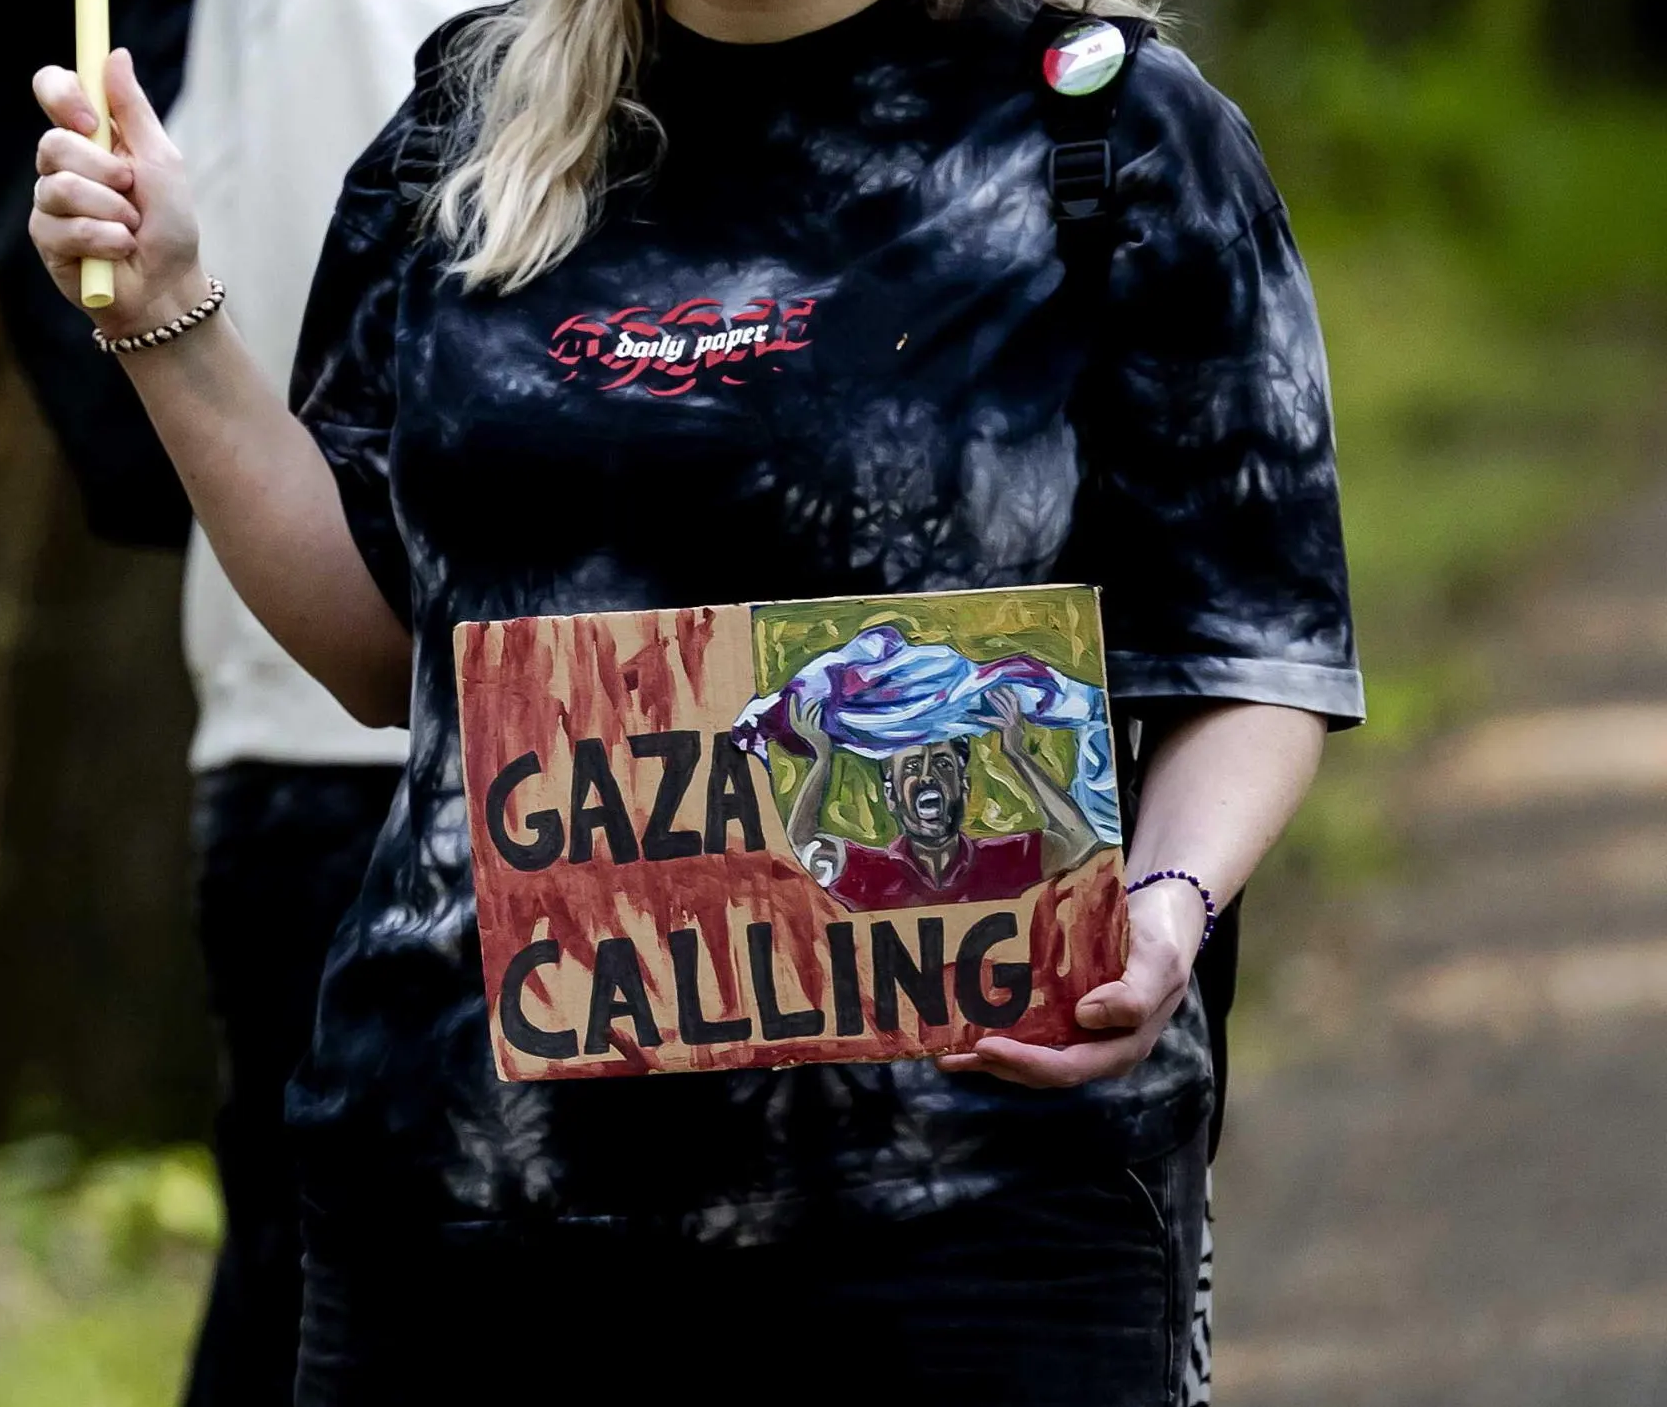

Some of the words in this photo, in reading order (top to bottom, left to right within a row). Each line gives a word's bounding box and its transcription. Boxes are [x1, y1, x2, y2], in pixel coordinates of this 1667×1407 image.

[616, 330, 687, 363] daily
[692, 323, 770, 360] paper
[484, 729, 766, 873] GAZA
[498, 911, 1033, 1061] CALLING
